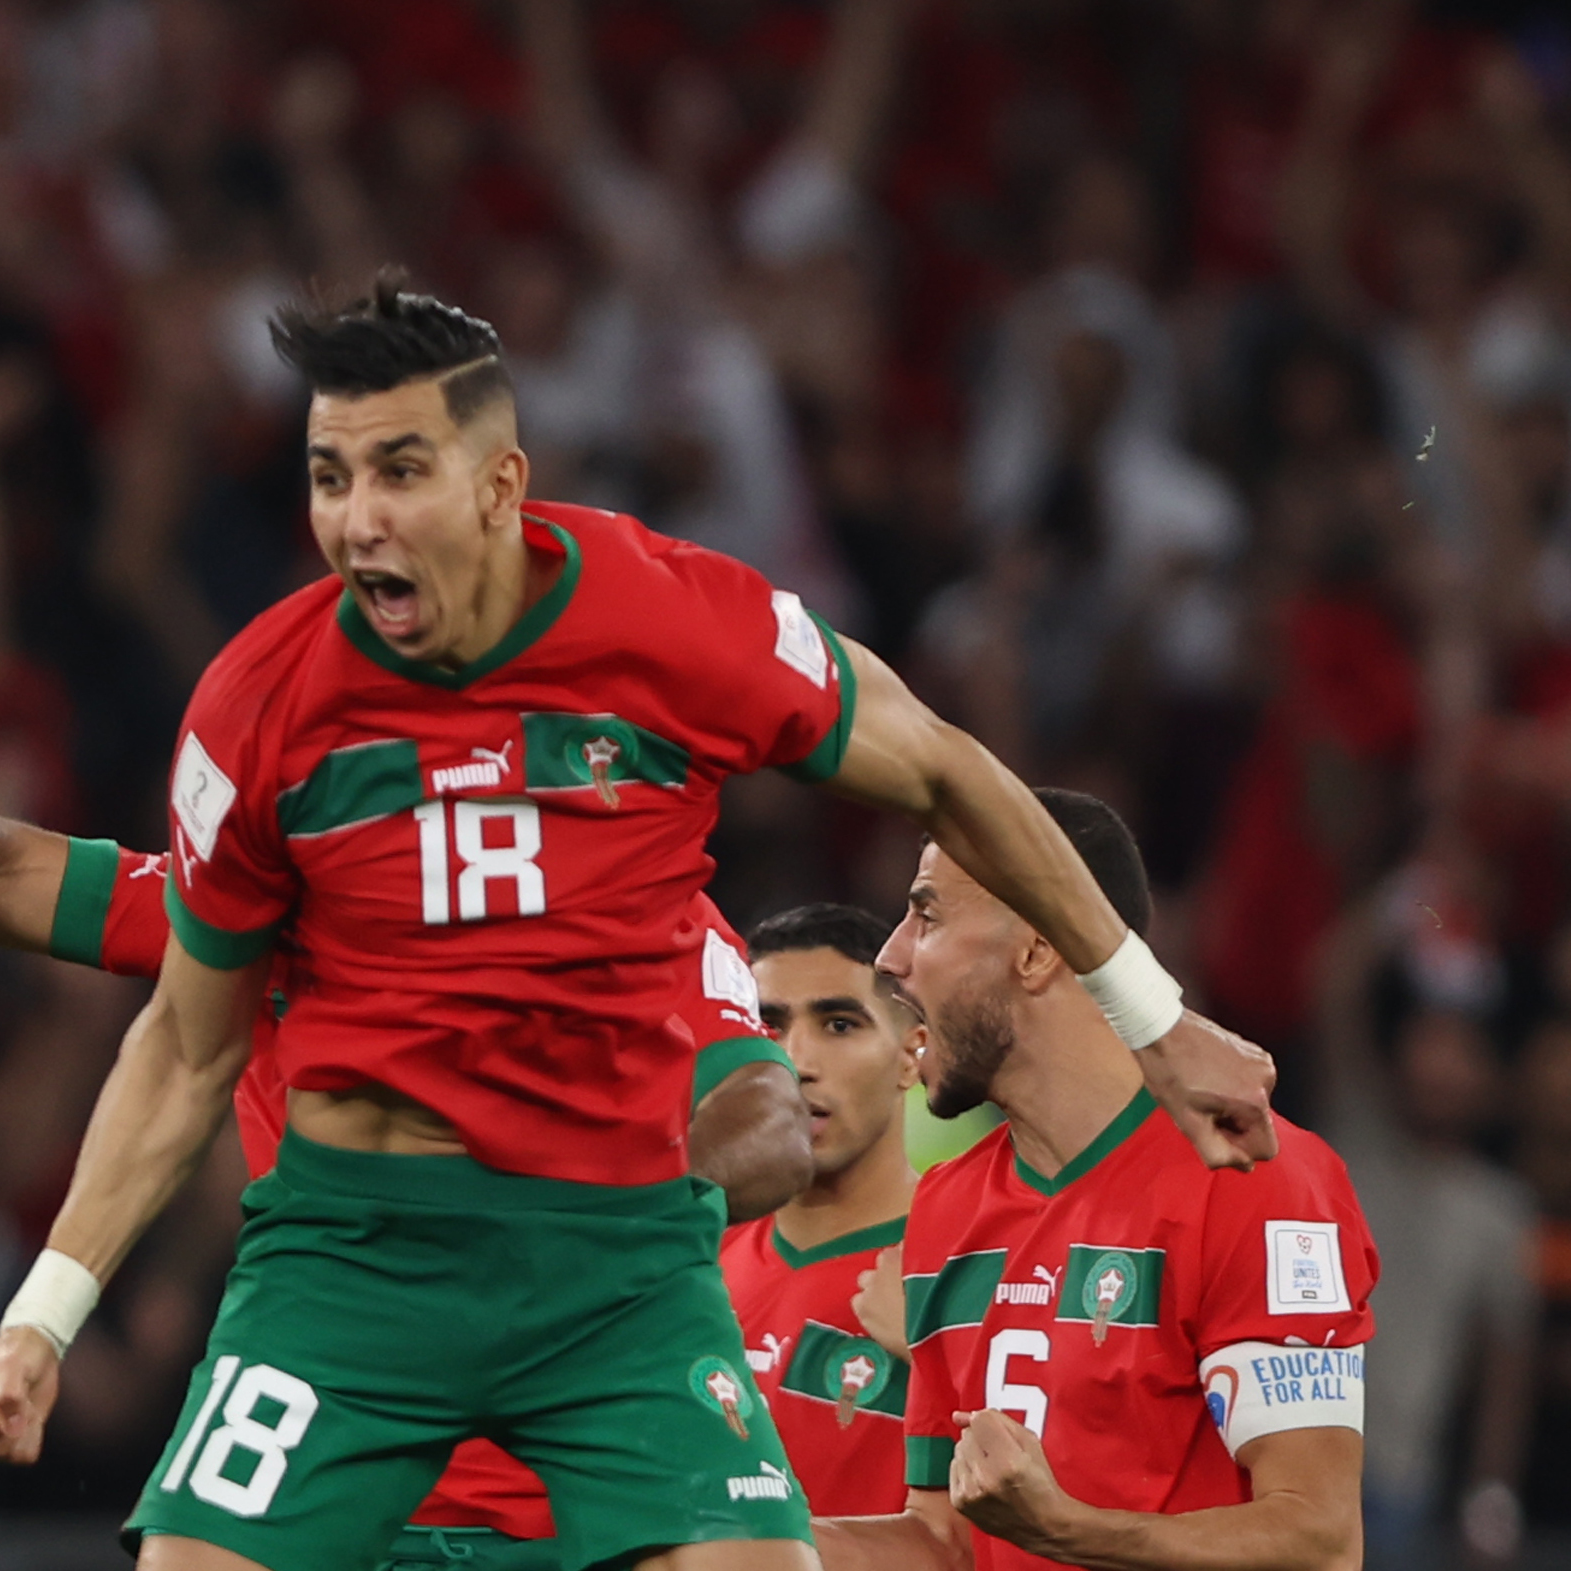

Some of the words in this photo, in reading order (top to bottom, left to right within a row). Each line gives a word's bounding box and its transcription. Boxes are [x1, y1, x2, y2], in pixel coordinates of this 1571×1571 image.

[432, 762, 499, 793] PUMA
[414, 800, 545, 925] 18
[995, 1283, 1050, 1305] PUMA
[1251, 1350, 1366, 1383] EDUCATIO
[986, 1329, 1050, 1439] 6
[1262, 1380, 1304, 1406] FOR
[1311, 1377, 1346, 1401] ALL
[160, 1355, 319, 1518] 18
[728, 1476, 787, 1501] PUMA
